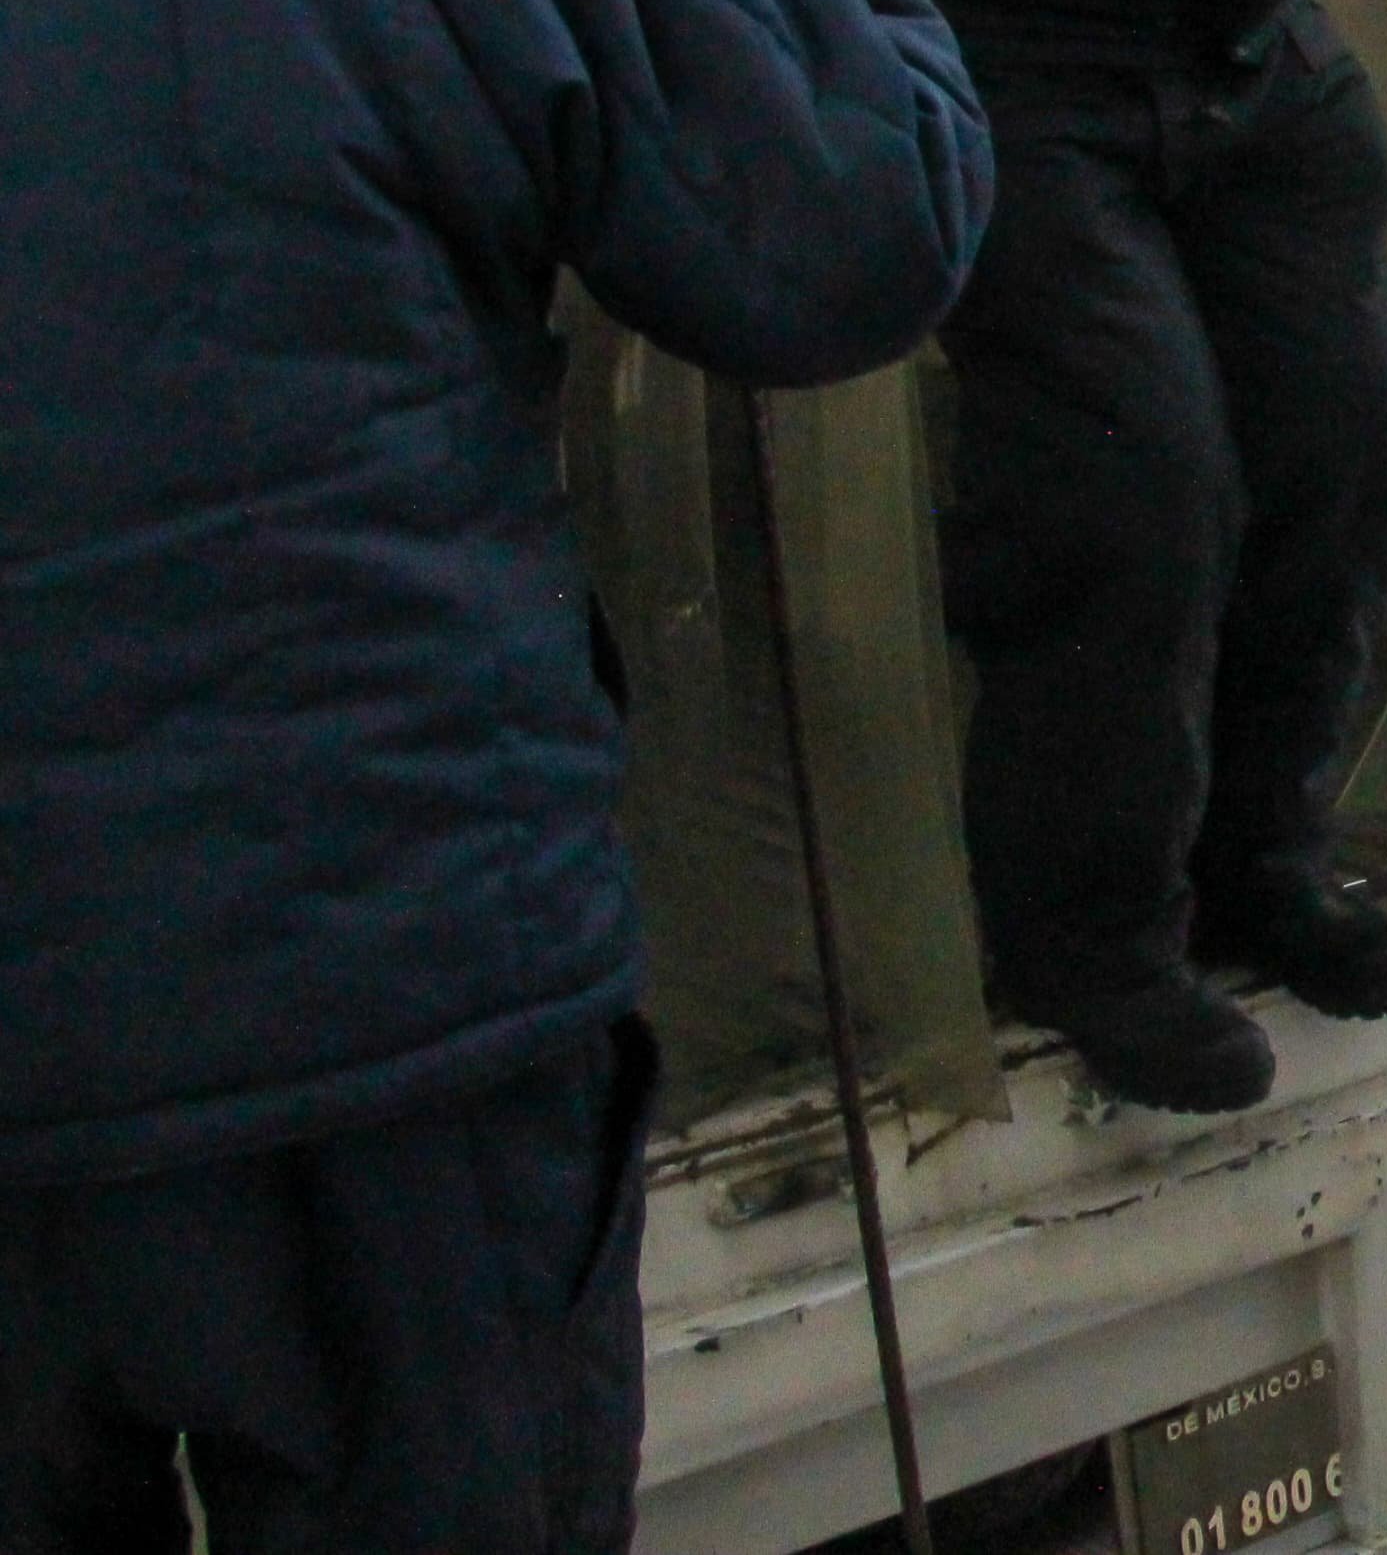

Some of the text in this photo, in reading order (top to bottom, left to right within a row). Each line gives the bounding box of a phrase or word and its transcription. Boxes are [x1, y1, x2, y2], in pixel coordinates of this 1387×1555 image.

[1166, 1411, 1199, 1442] DE
[1181, 1500, 1227, 1555] 01
[1241, 1467, 1313, 1537] 800
